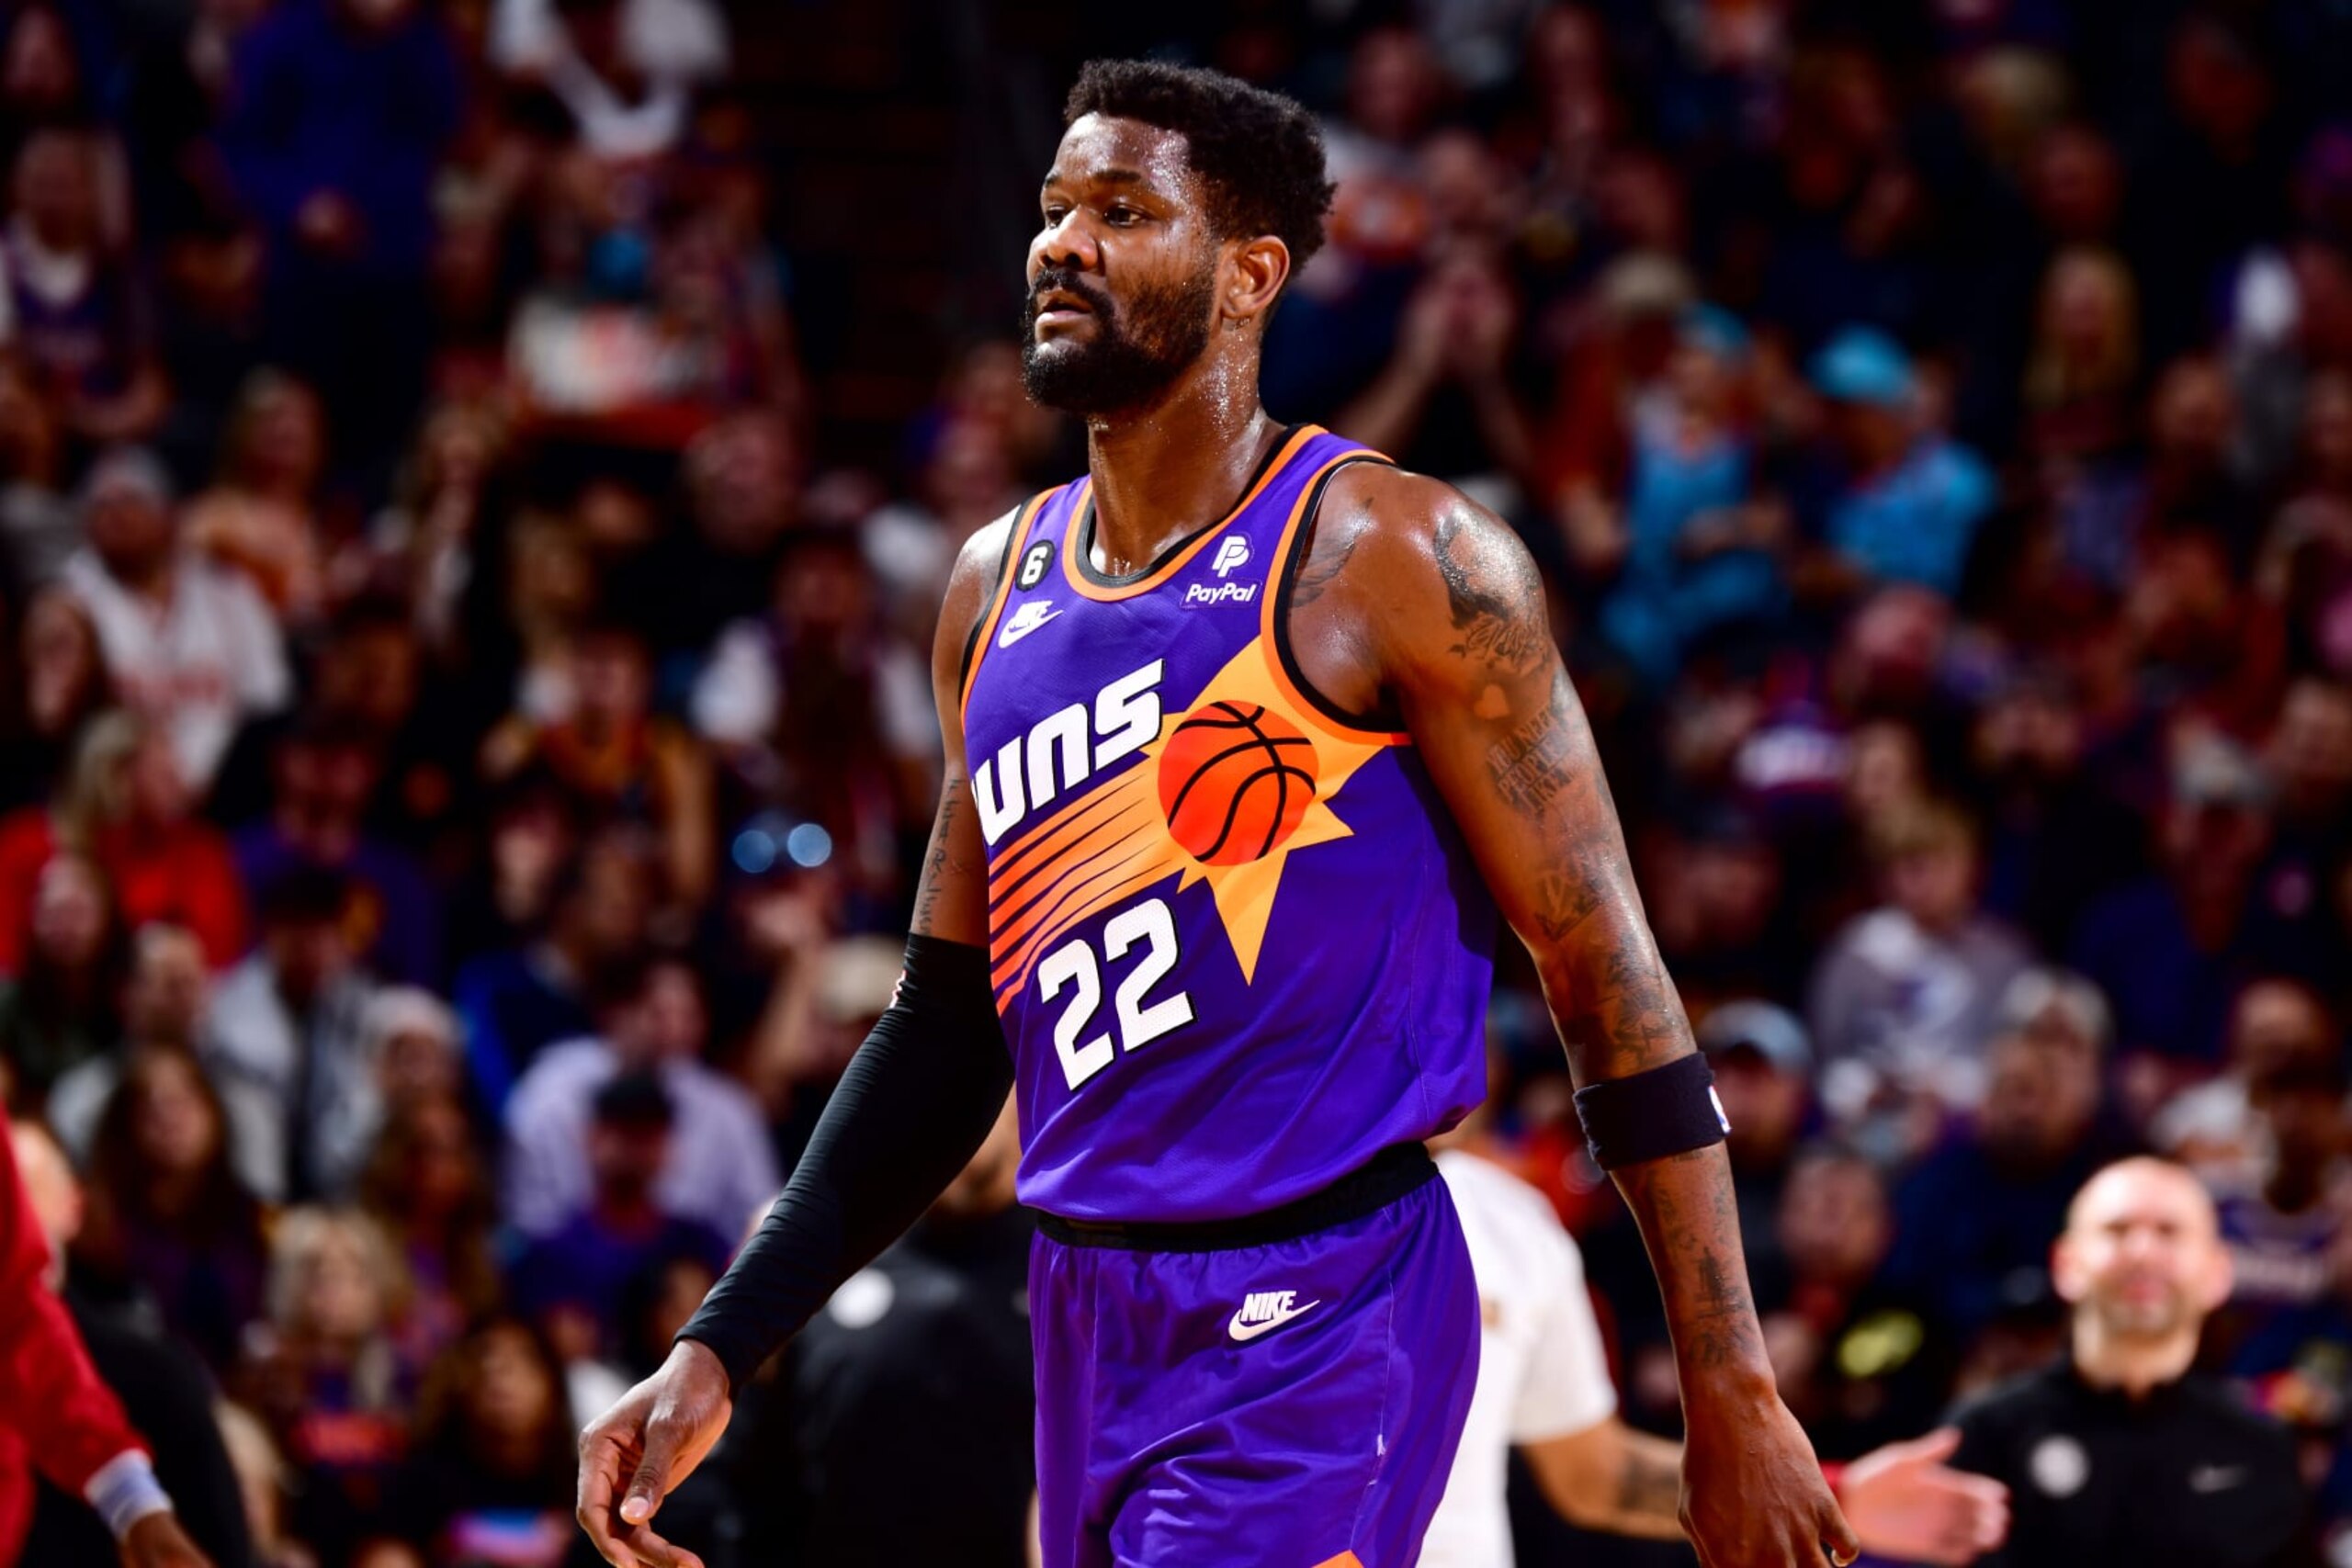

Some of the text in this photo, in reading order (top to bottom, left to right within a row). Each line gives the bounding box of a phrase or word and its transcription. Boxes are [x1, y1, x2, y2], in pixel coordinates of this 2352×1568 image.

[1021, 546, 1048, 585] 6
[1185, 581, 1257, 604] PayPal
[1037, 897, 1196, 1091] 22
[1239, 1291, 1297, 1322] NIKE
